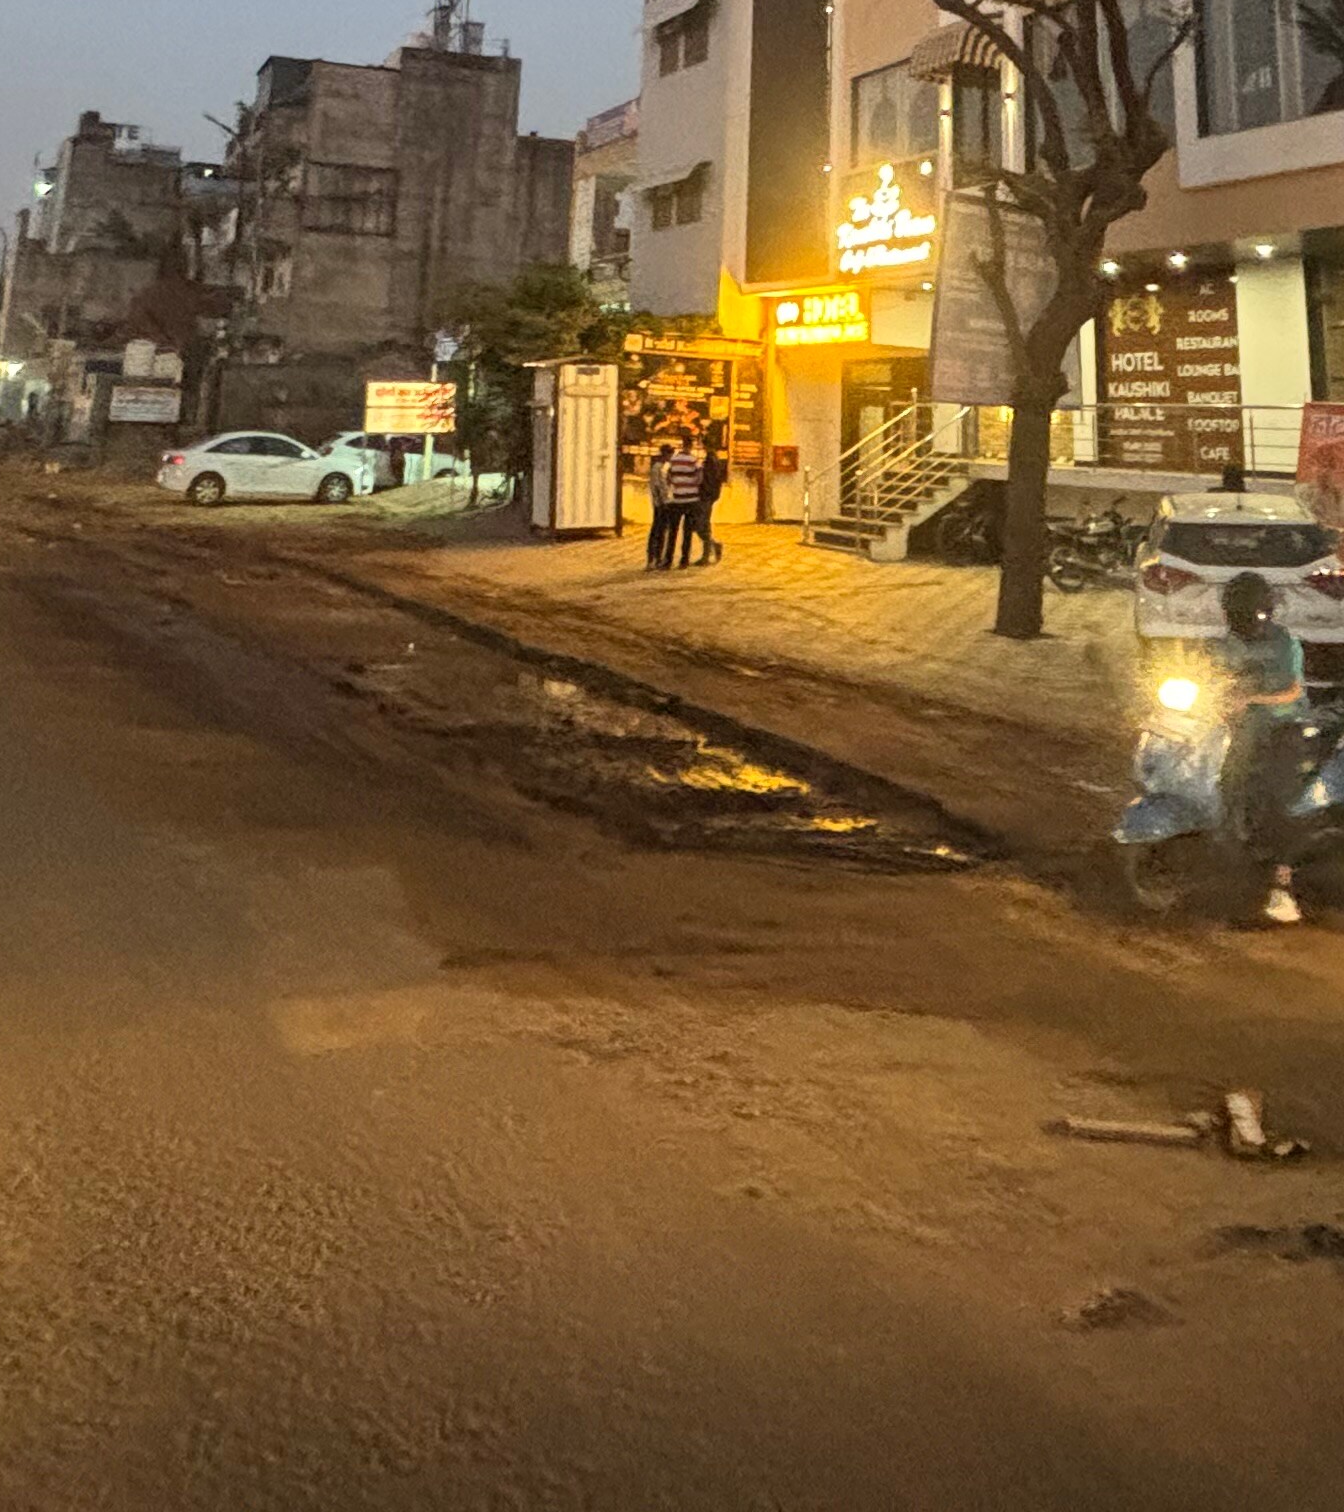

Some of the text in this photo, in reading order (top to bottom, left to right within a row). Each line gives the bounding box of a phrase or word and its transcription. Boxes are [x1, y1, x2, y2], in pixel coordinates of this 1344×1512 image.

[1187, 307, 1229, 323] ROOMS
[1176, 335, 1239, 350] RESTAURAN
[1111, 351, 1164, 373] HOTEL
[1177, 363, 1240, 377] LOUNGE BA
[1108, 379, 1171, 398] KAUSHIKI
[1187, 390, 1238, 404] BANQUET
[1200, 445, 1231, 461] CAFE
